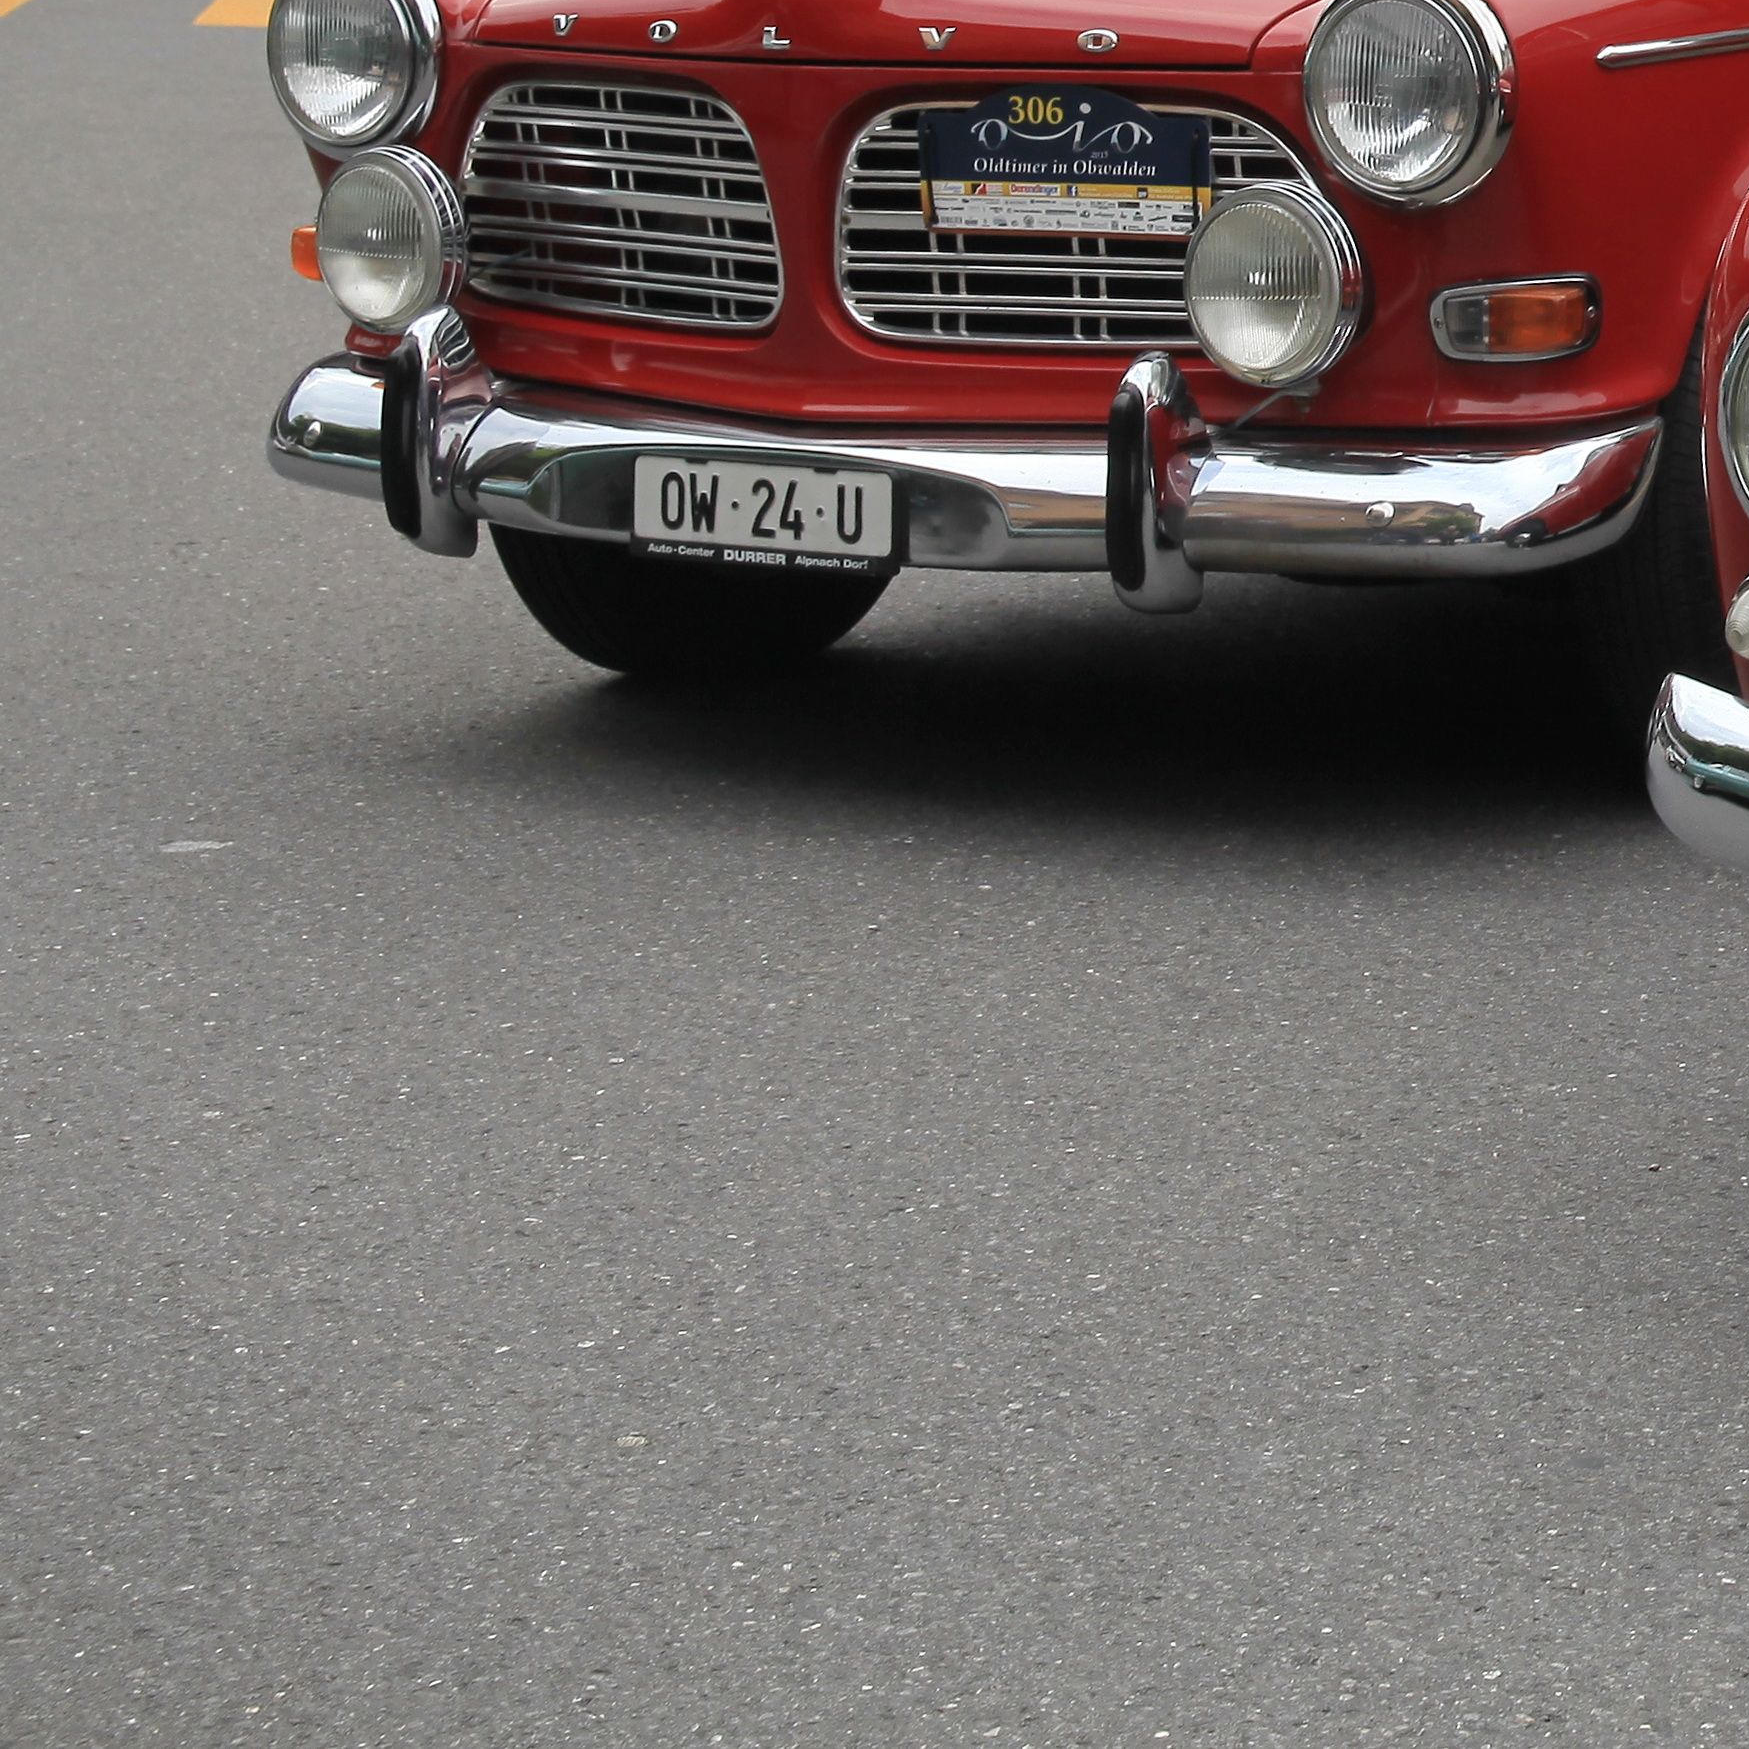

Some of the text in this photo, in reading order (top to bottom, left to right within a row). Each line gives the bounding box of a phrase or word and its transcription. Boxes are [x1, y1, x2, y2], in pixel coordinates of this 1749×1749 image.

[553, 13, 1119, 52] VOLVO
[1008, 95, 1064, 125] 306
[974, 157, 1157, 177] Oldtimer in Obwalden
[723, 548, 787, 566] DURRER
[794, 554, 840, 568] Alpnach
[843, 557, 869, 570] Dorf
